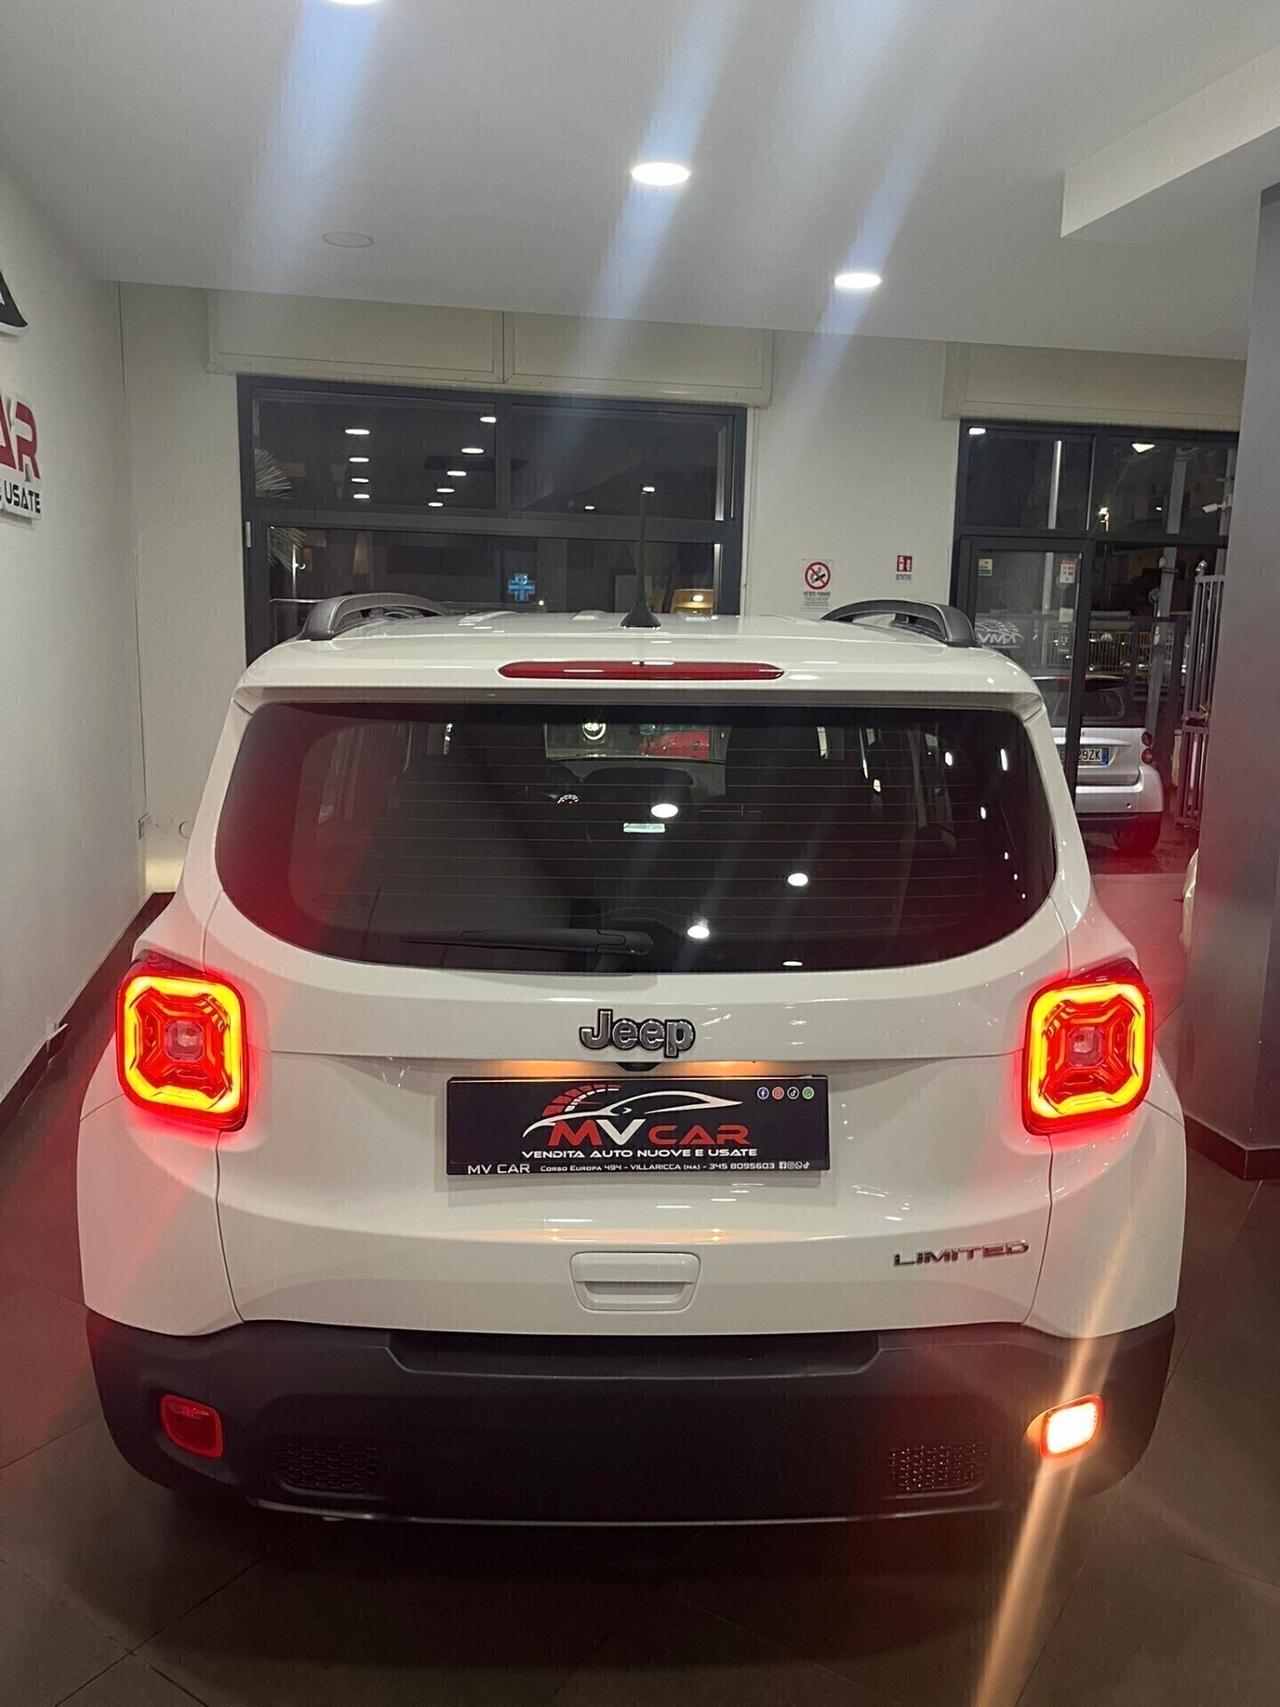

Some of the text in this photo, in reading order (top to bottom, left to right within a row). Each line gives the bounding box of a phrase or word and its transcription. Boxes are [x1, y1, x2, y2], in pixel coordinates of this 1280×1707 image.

[4, 480, 41, 514] USATE
[579, 1008, 696, 1058] Jeep
[547, 1118, 751, 1146] MV CAR
[521, 1148, 758, 1159] VENDITA AUTO NUOVE E USATE
[467, 1163, 531, 1175] MV CAR
[630, 1163, 682, 1171] VILLARICCA
[893, 1240, 1030, 1266] LIMITED
